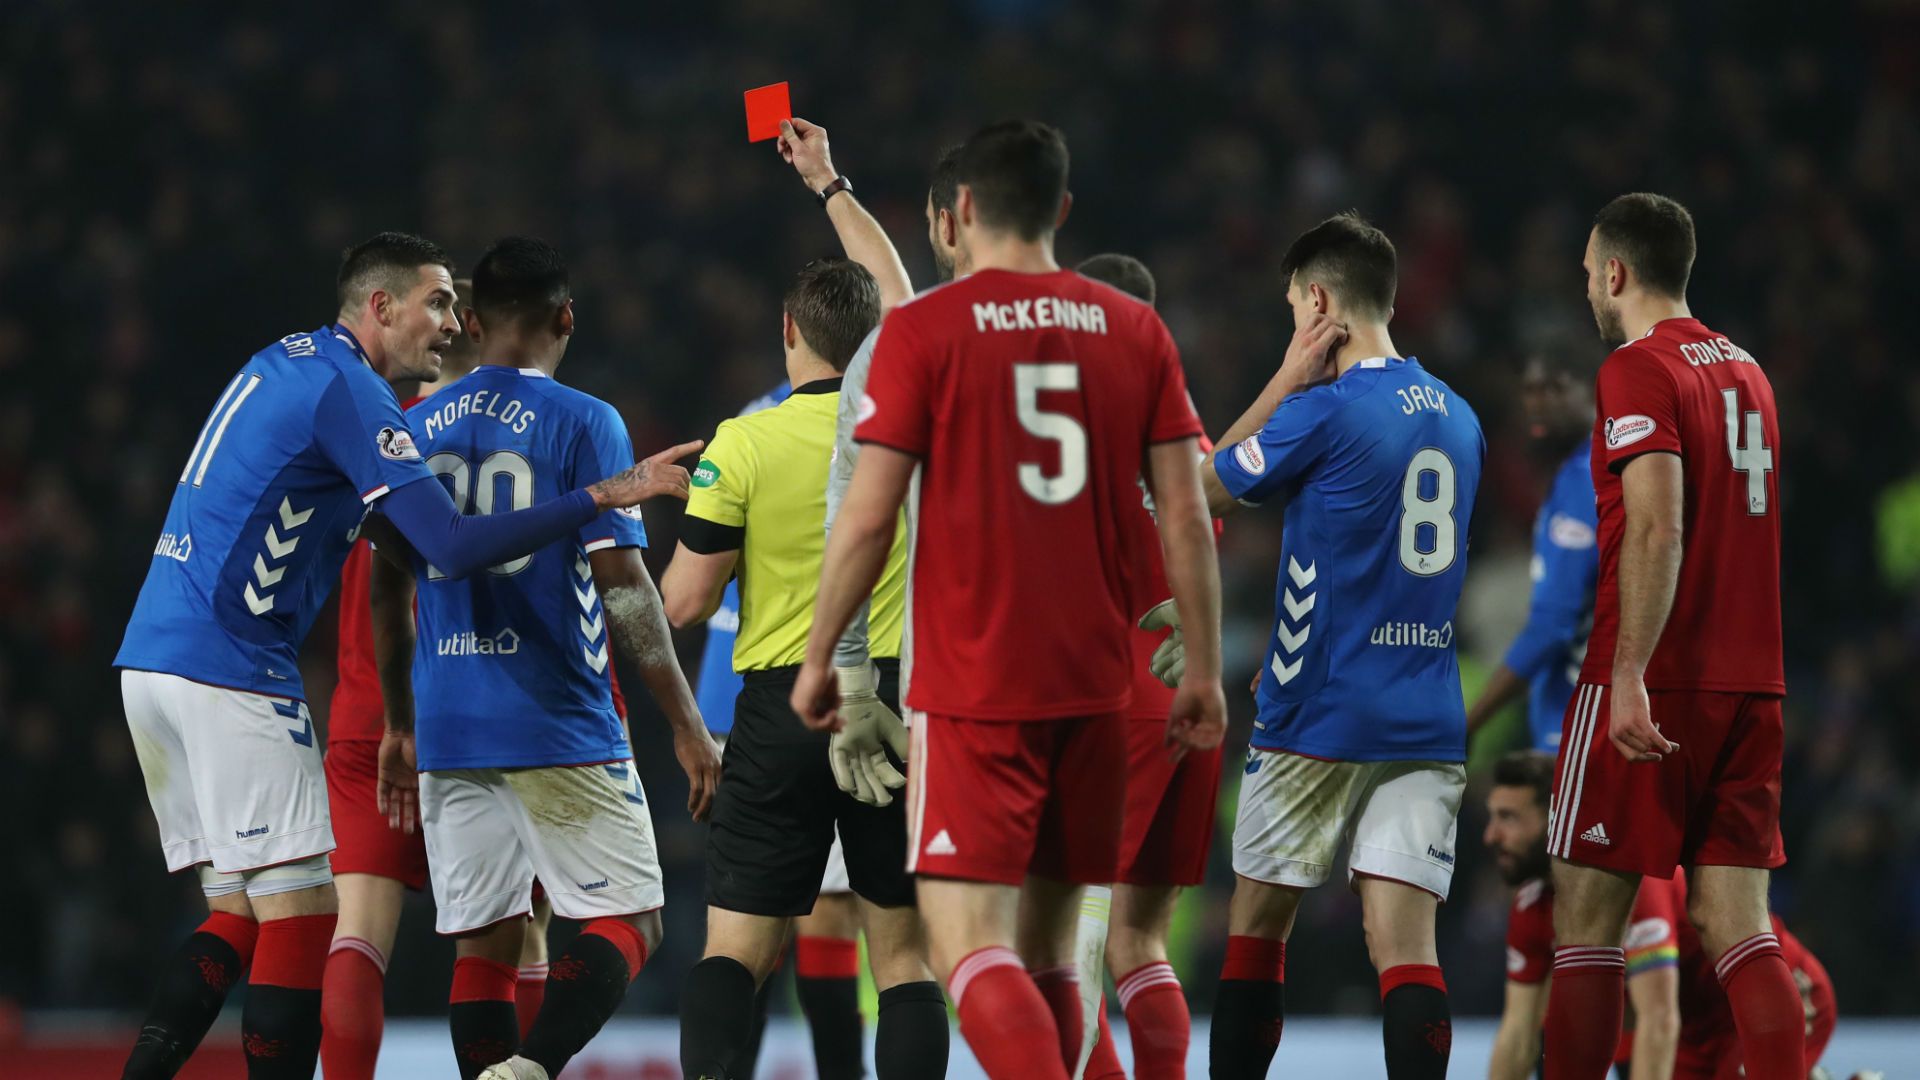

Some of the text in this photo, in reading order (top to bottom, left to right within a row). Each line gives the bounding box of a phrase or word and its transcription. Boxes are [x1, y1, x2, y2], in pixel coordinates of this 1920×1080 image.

[972, 297, 1107, 334] McKENNA
[425, 390, 536, 440] MORELOS
[1396, 384, 1449, 417] JACK
[179, 372, 263, 488] 11
[1014, 364, 1088, 505] 5
[1613, 419, 1649, 436] Ladbrokes
[1721, 388, 1774, 516] 4
[1399, 446, 1457, 577] 8
[1370, 621, 1440, 648] utilita
[235, 824, 269, 839] hummel
[1580, 834, 1610, 846] adidas
